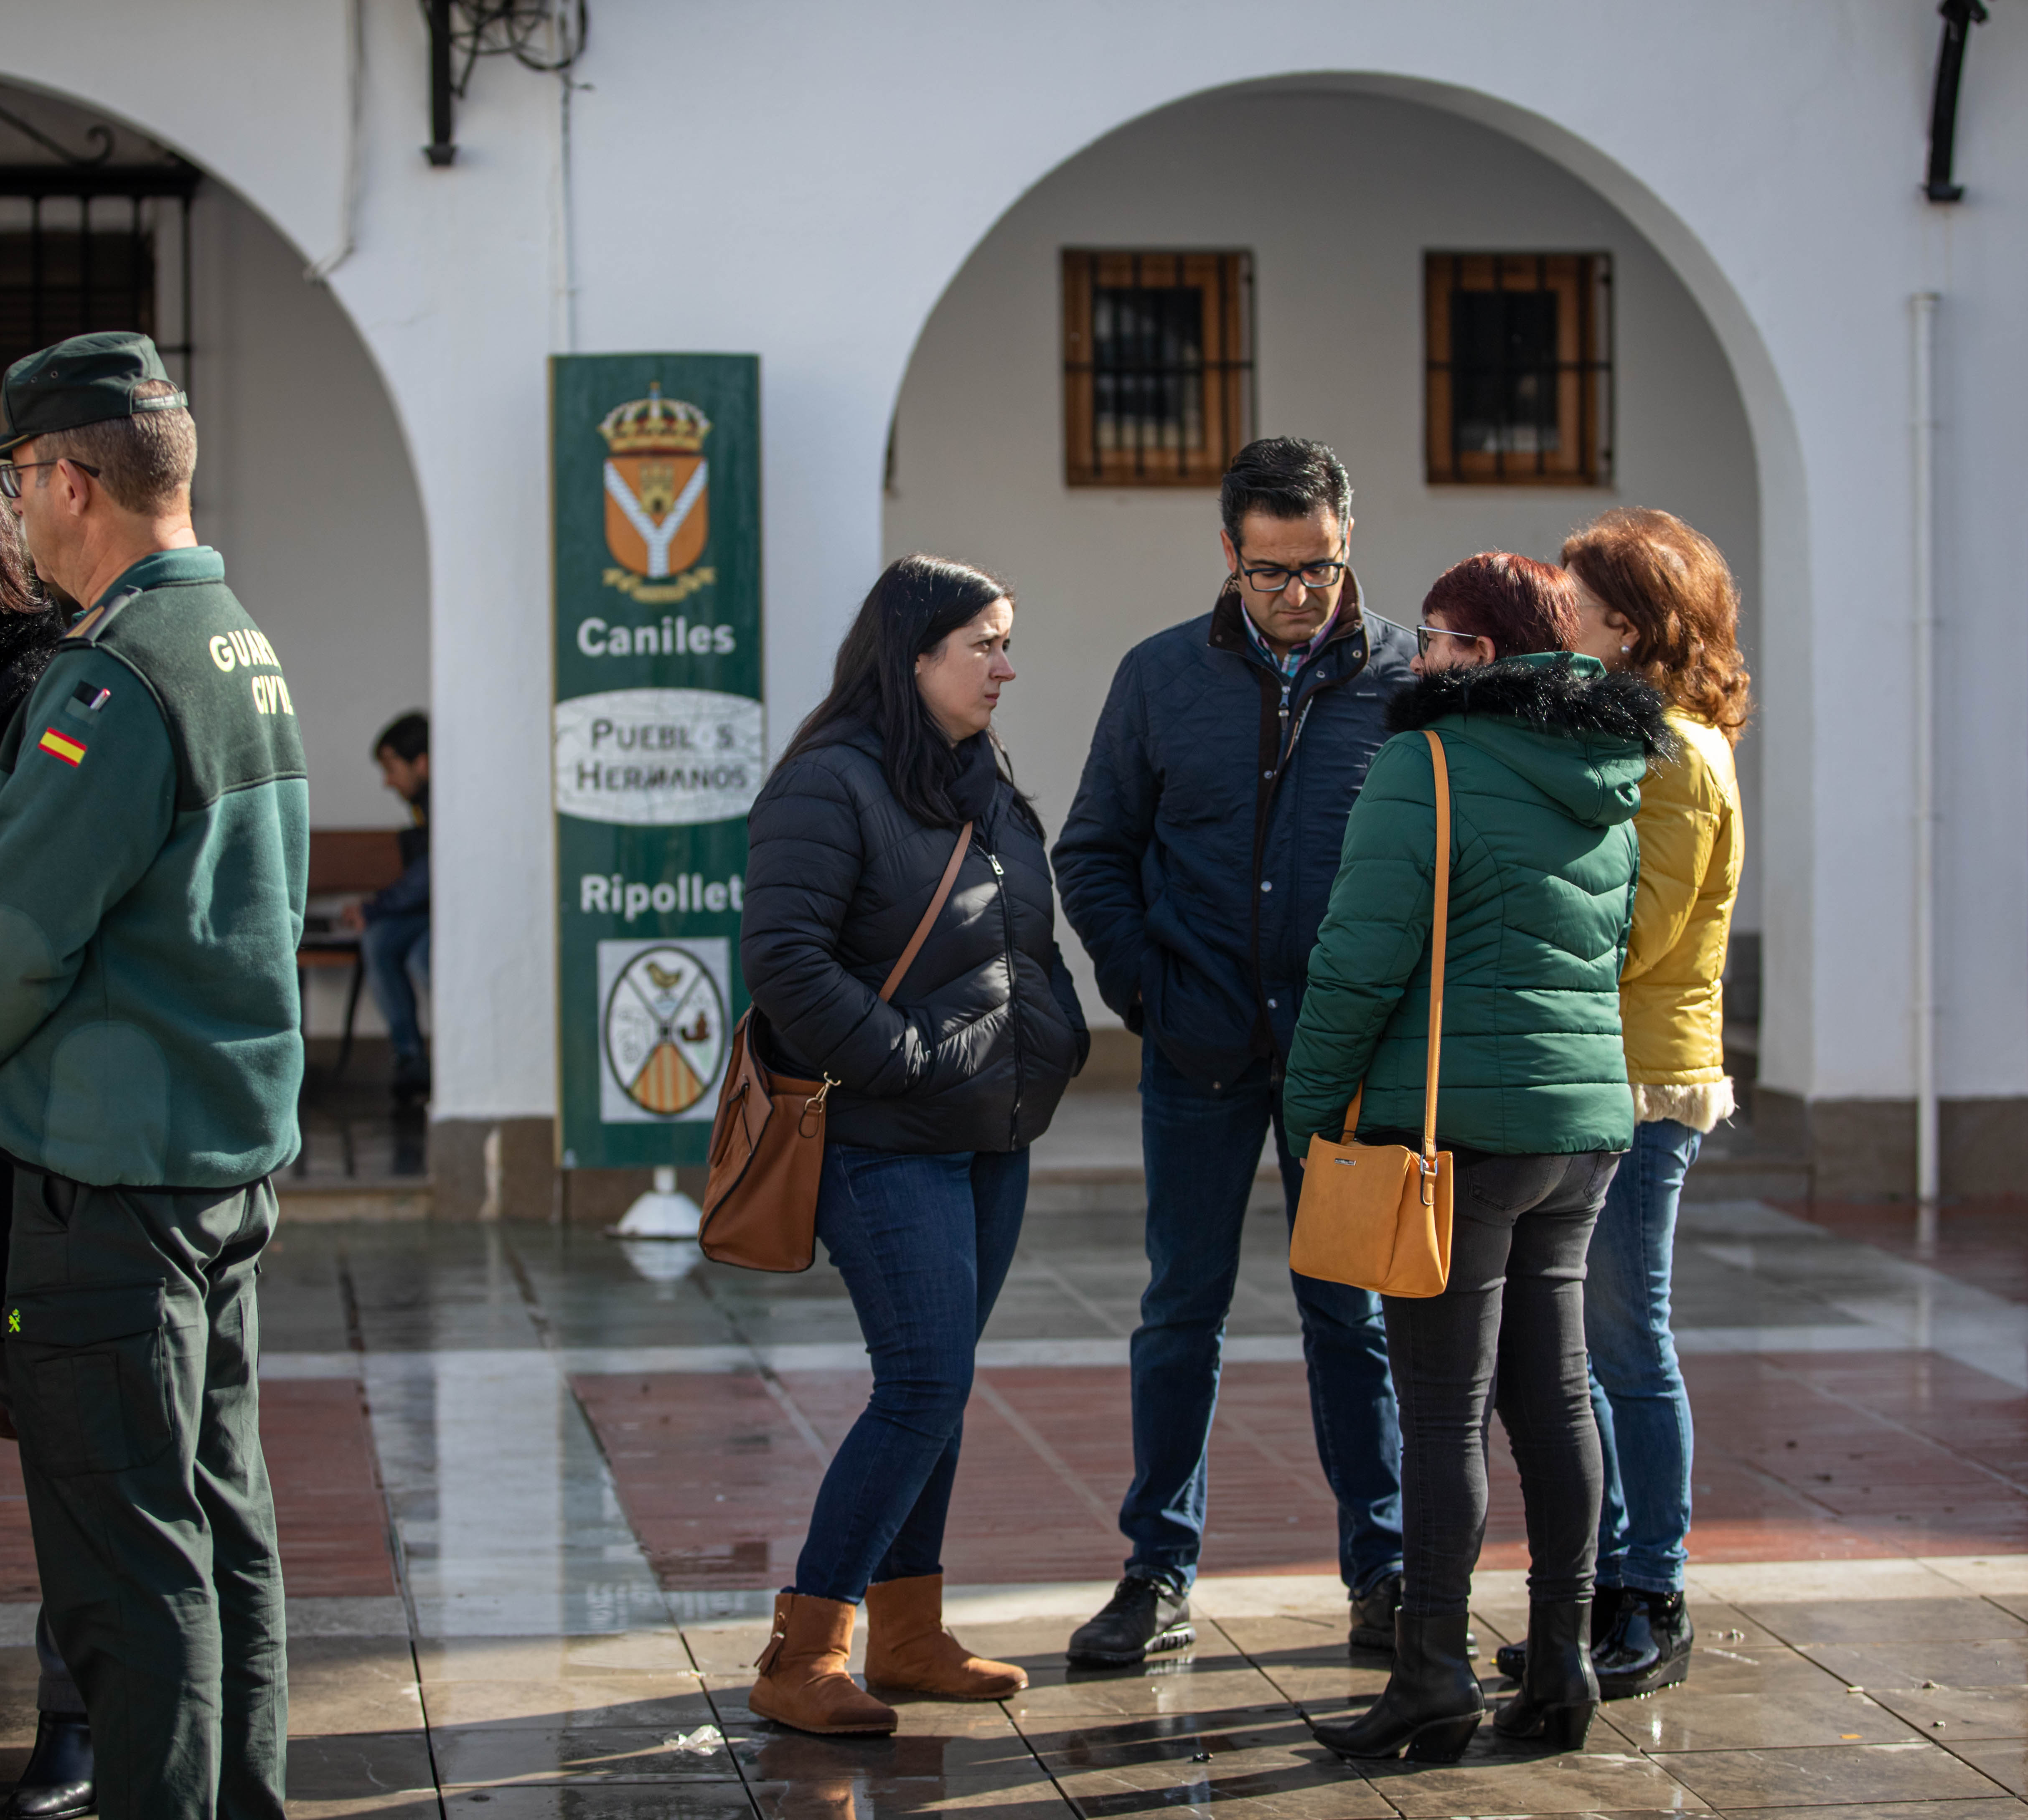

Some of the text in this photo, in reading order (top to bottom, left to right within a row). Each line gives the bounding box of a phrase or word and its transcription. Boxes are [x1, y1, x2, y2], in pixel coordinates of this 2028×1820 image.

[577, 616, 736, 657] Caniles
[577, 760, 747, 790] HERMANOS
[581, 873, 743, 922] Ripollet
